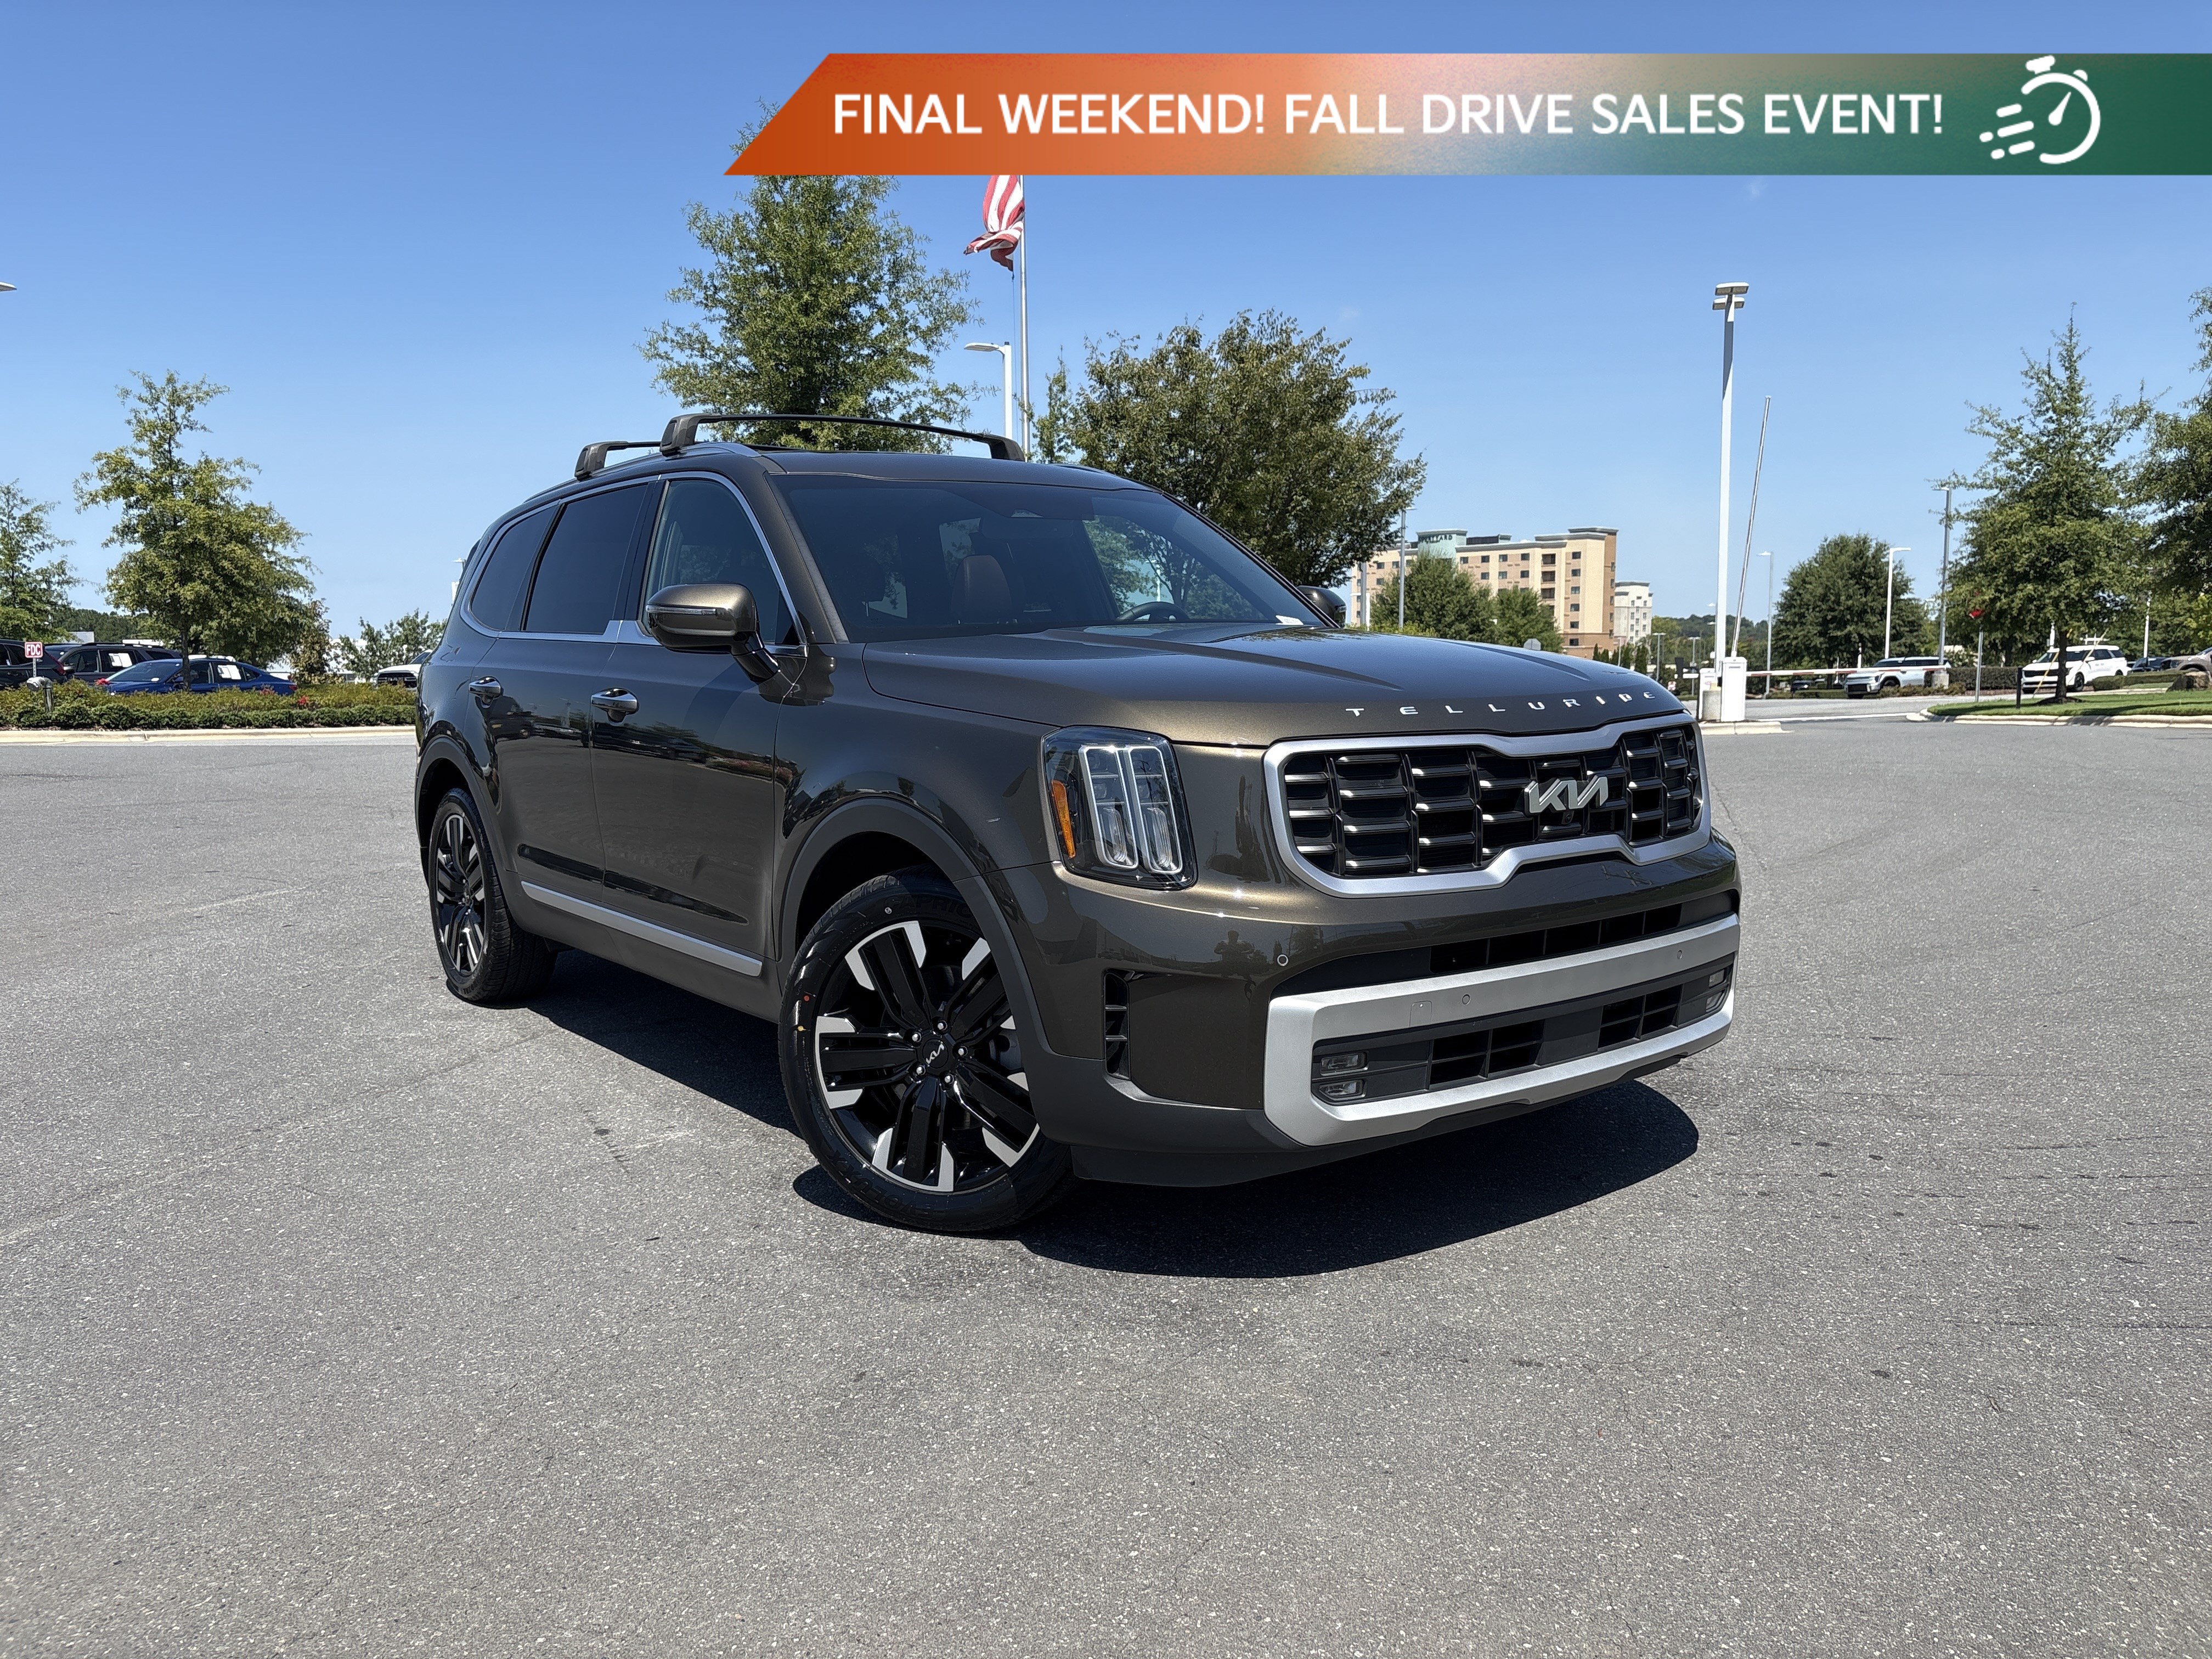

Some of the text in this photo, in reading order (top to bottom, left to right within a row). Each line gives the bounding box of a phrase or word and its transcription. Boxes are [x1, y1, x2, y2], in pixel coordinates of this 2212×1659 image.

[26, 644, 41, 656] FDC
[1346, 691, 1655, 716] TELLURIDE
[1527, 776, 1608, 814] KIA
[926, 1043, 945, 1064] KIA
